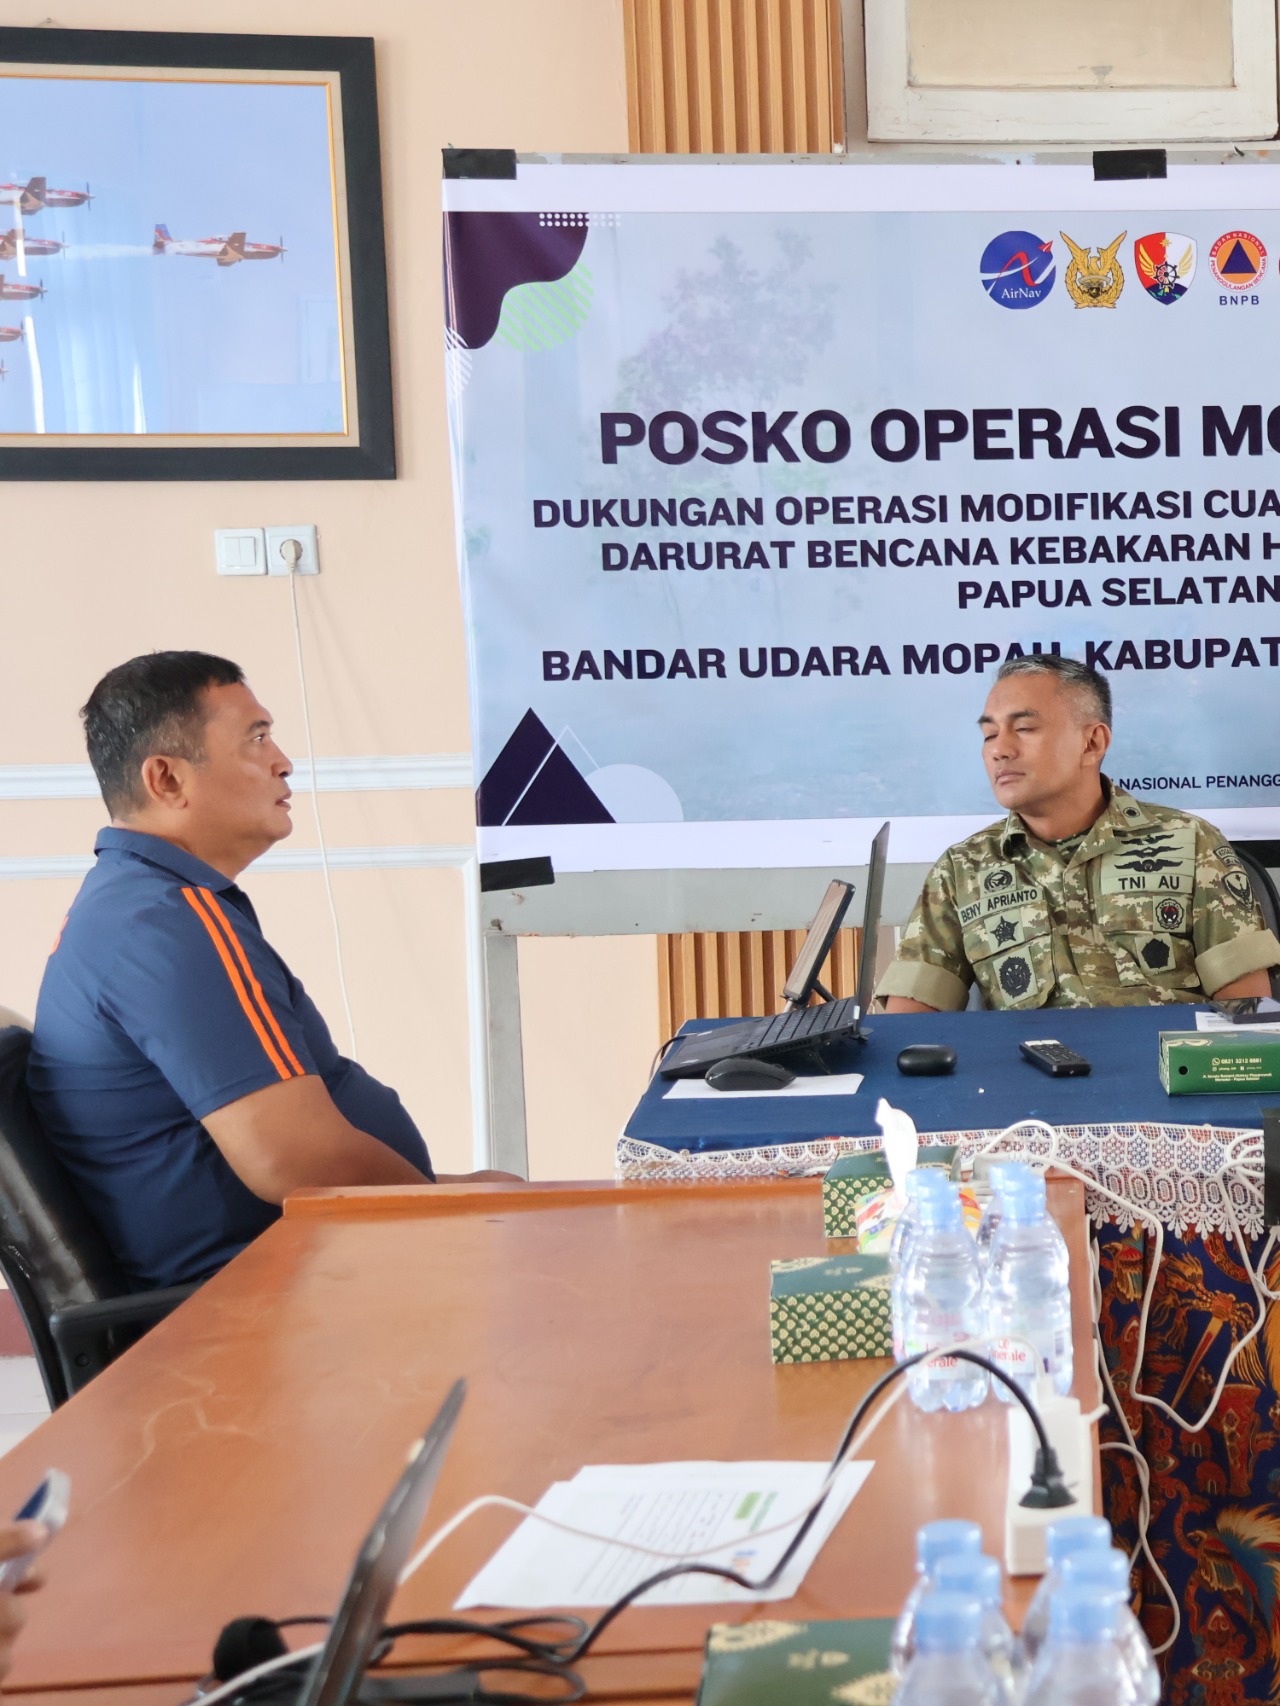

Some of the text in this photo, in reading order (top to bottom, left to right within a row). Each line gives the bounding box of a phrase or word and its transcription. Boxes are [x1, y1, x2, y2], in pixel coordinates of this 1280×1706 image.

[1001, 285, 1042, 299] AirNav
[1220, 296, 1259, 305] BNPB
[601, 410, 850, 465] POSKO
[871, 406, 1180, 462] OPERASI
[534, 498, 763, 528] DUKUNGAN
[776, 495, 947, 525] OPERASI
[961, 491, 1191, 522] MODIFIKASI
[602, 541, 795, 571] DARURAT
[808, 538, 999, 568] BENCANA
[1011, 533, 1250, 564] KEBAKARAN
[959, 580, 1091, 609] PAPUA
[1102, 575, 1280, 606] SELATAN
[543, 648, 726, 681] BANDAR
[740, 646, 890, 678] UDARA
[1119, 777, 1201, 790] NASIONAL
[1118, 875, 1180, 890] TNI AU
[960, 889, 1038, 923] BENY APRIANTO
